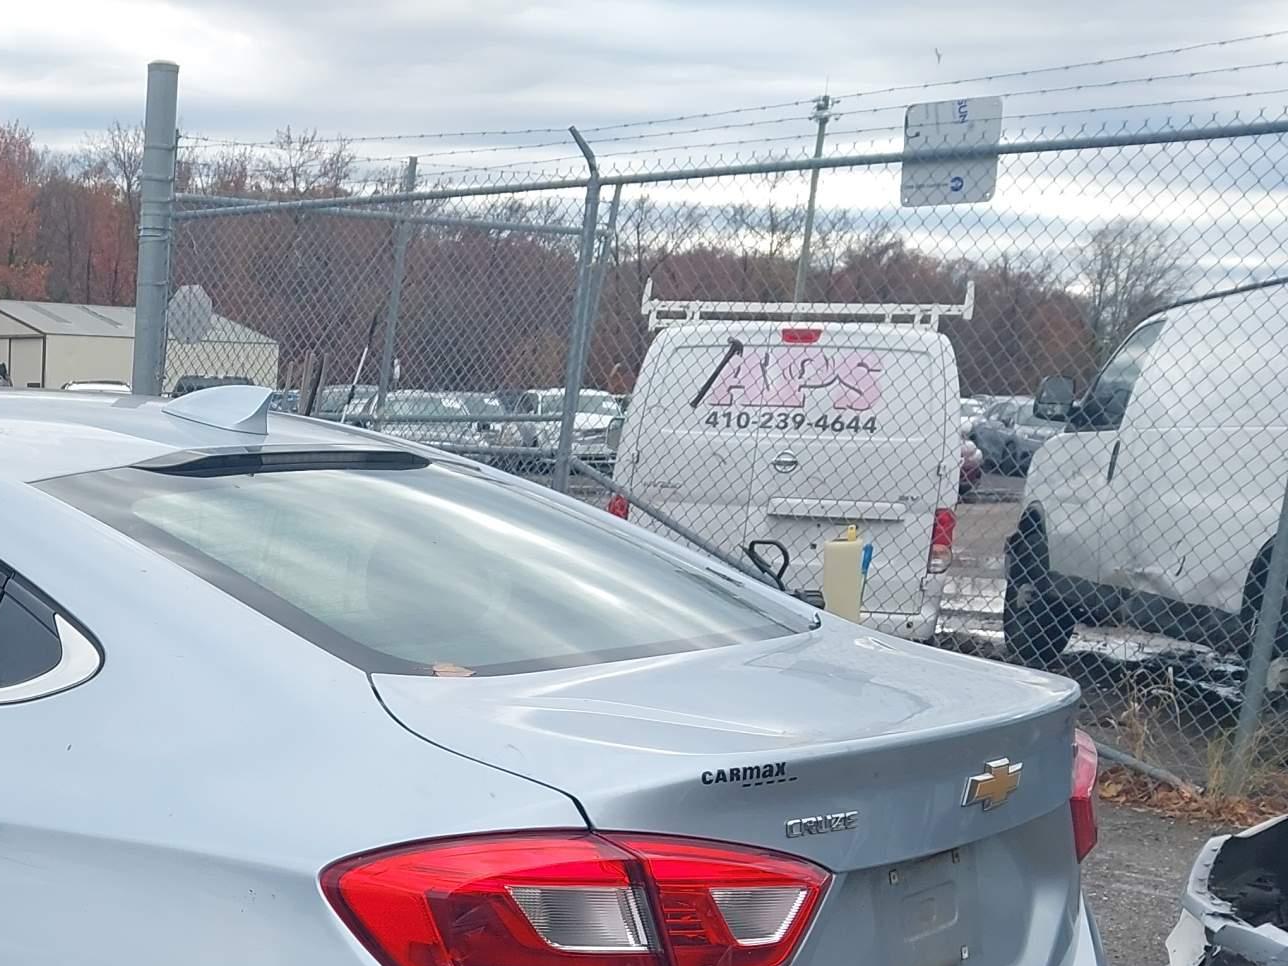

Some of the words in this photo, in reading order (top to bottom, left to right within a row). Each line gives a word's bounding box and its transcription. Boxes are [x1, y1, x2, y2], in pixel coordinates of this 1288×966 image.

[708, 347, 883, 411] APS
[704, 410, 878, 434] 410-239-4644
[785, 810, 859, 839] CRUZE
